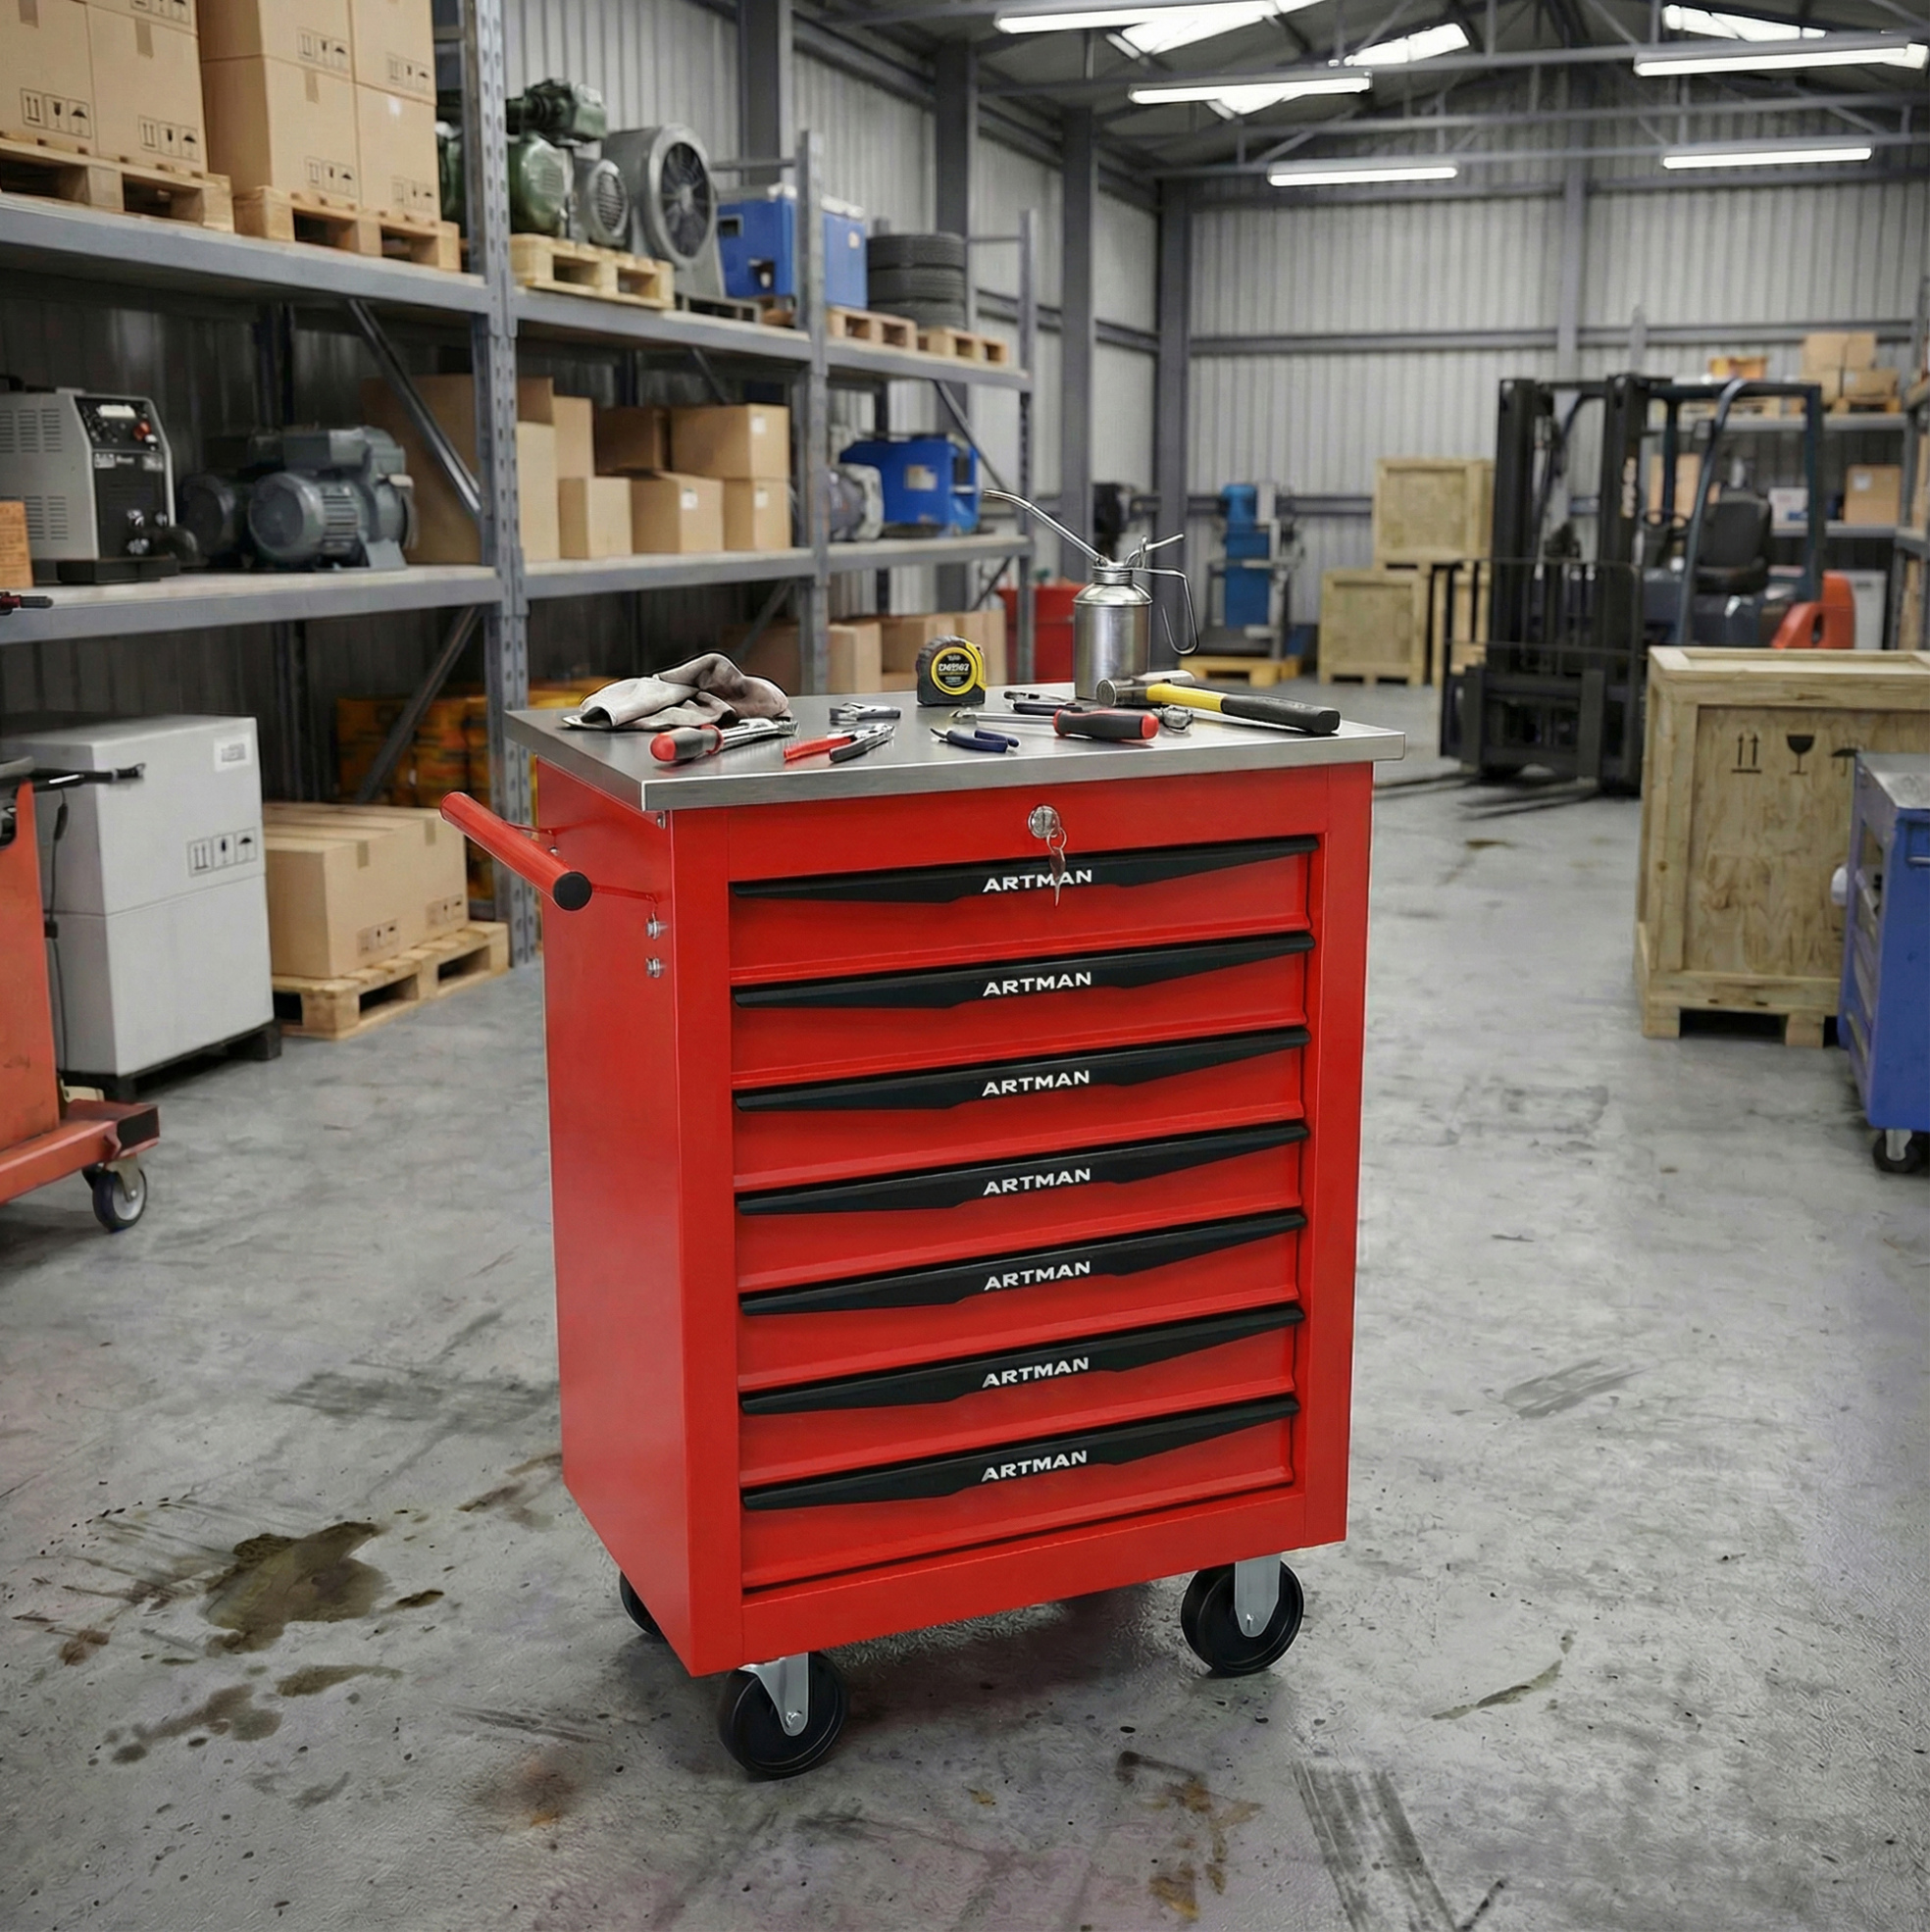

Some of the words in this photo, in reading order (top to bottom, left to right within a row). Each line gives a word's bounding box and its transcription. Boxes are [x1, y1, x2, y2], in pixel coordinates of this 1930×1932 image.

[982, 869, 1092, 892] ARTMAN
[983, 971, 1092, 997] ARTMAN
[982, 1069, 1090, 1097] ARTMAN
[983, 1168, 1091, 1195] ARTMAN
[984, 1261, 1091, 1291] ARTMAN
[982, 1357, 1089, 1388] ARTMAN
[981, 1450, 1087, 1482] ARTMAN
